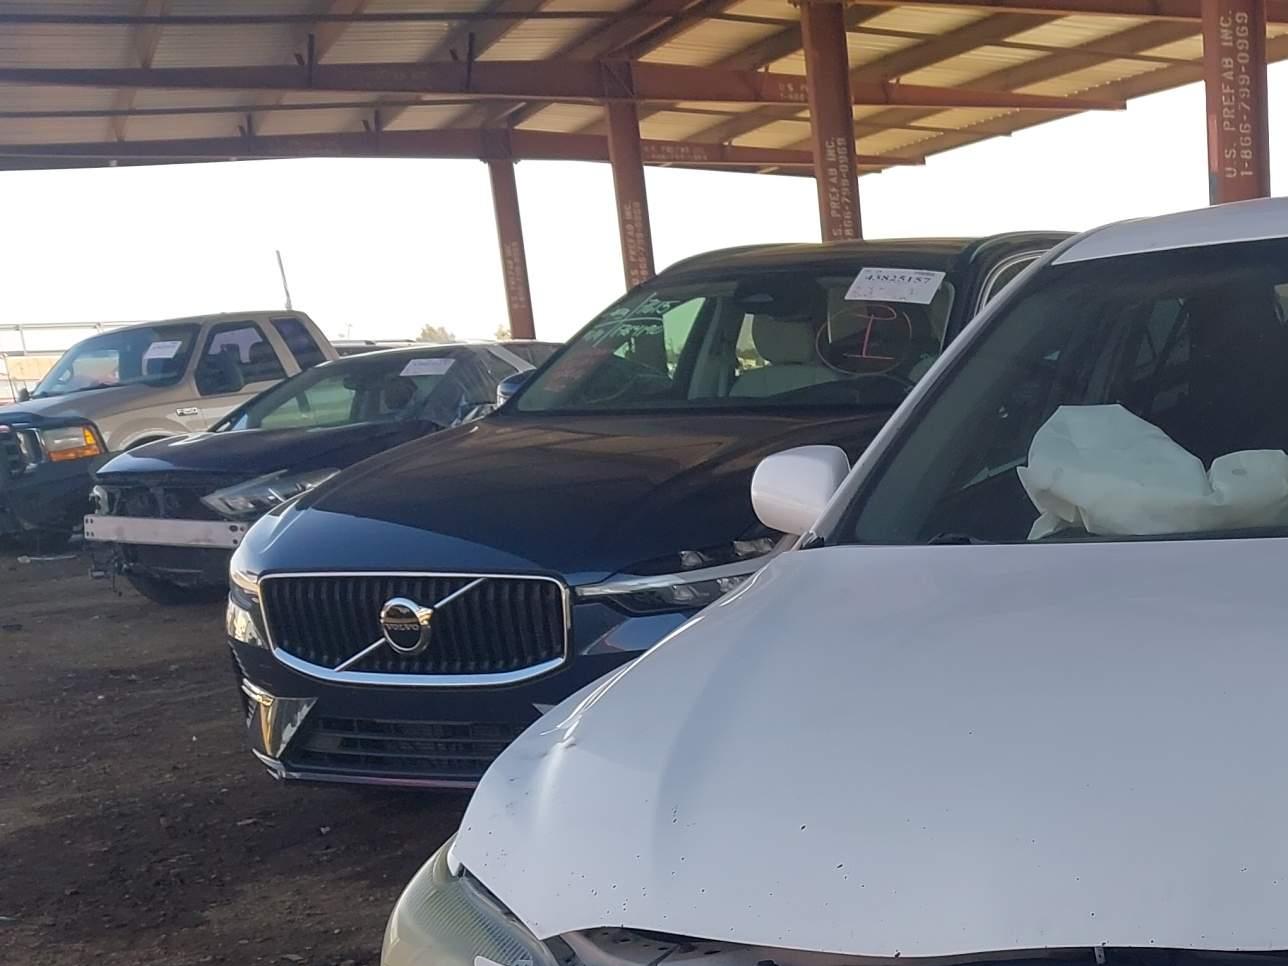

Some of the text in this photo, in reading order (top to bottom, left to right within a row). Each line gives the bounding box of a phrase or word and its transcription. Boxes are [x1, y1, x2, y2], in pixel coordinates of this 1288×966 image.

[1219, 9, 1238, 179] U.S. PREFAB INC.
